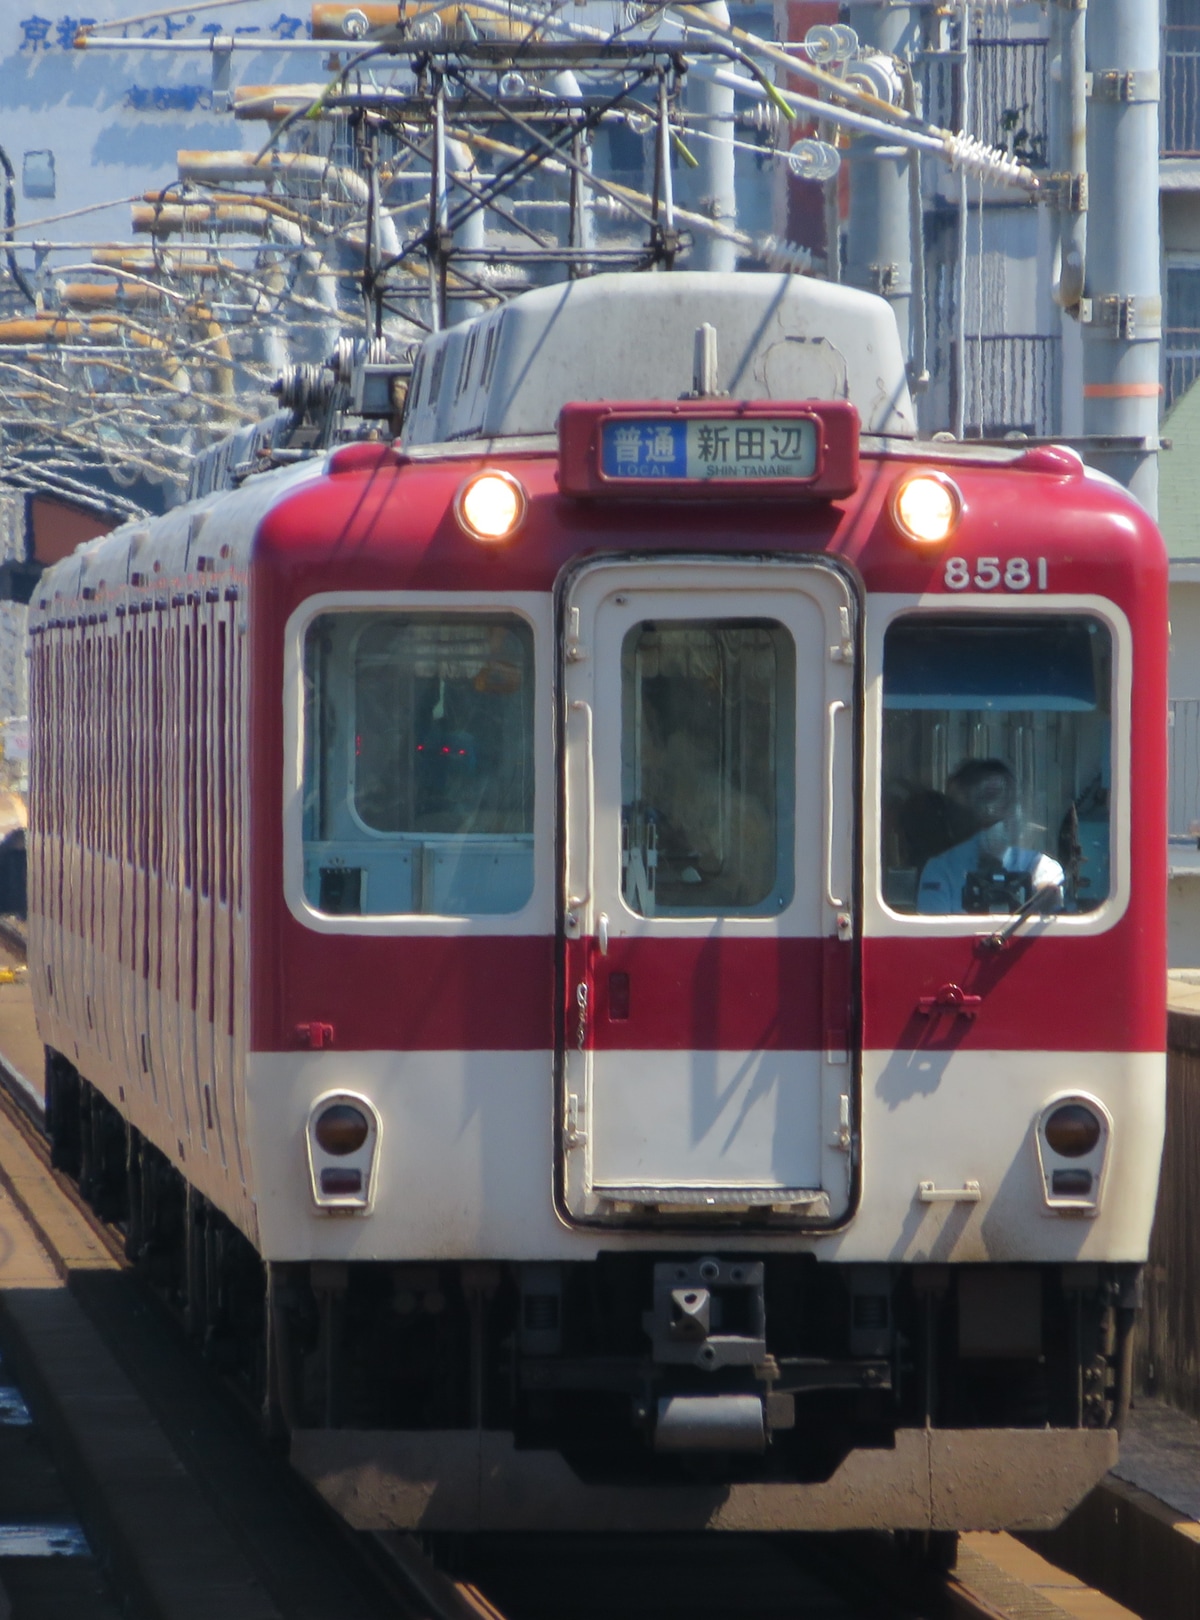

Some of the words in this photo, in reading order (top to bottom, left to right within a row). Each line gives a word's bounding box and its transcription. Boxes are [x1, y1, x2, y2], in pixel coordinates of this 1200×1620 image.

[613, 426, 676, 463] 普通
[698, 425, 802, 462] 新田辺
[617, 464, 668, 476] LOCAL
[706, 464, 793, 477] SHIN-TANABE
[944, 556, 1048, 590] 8581
